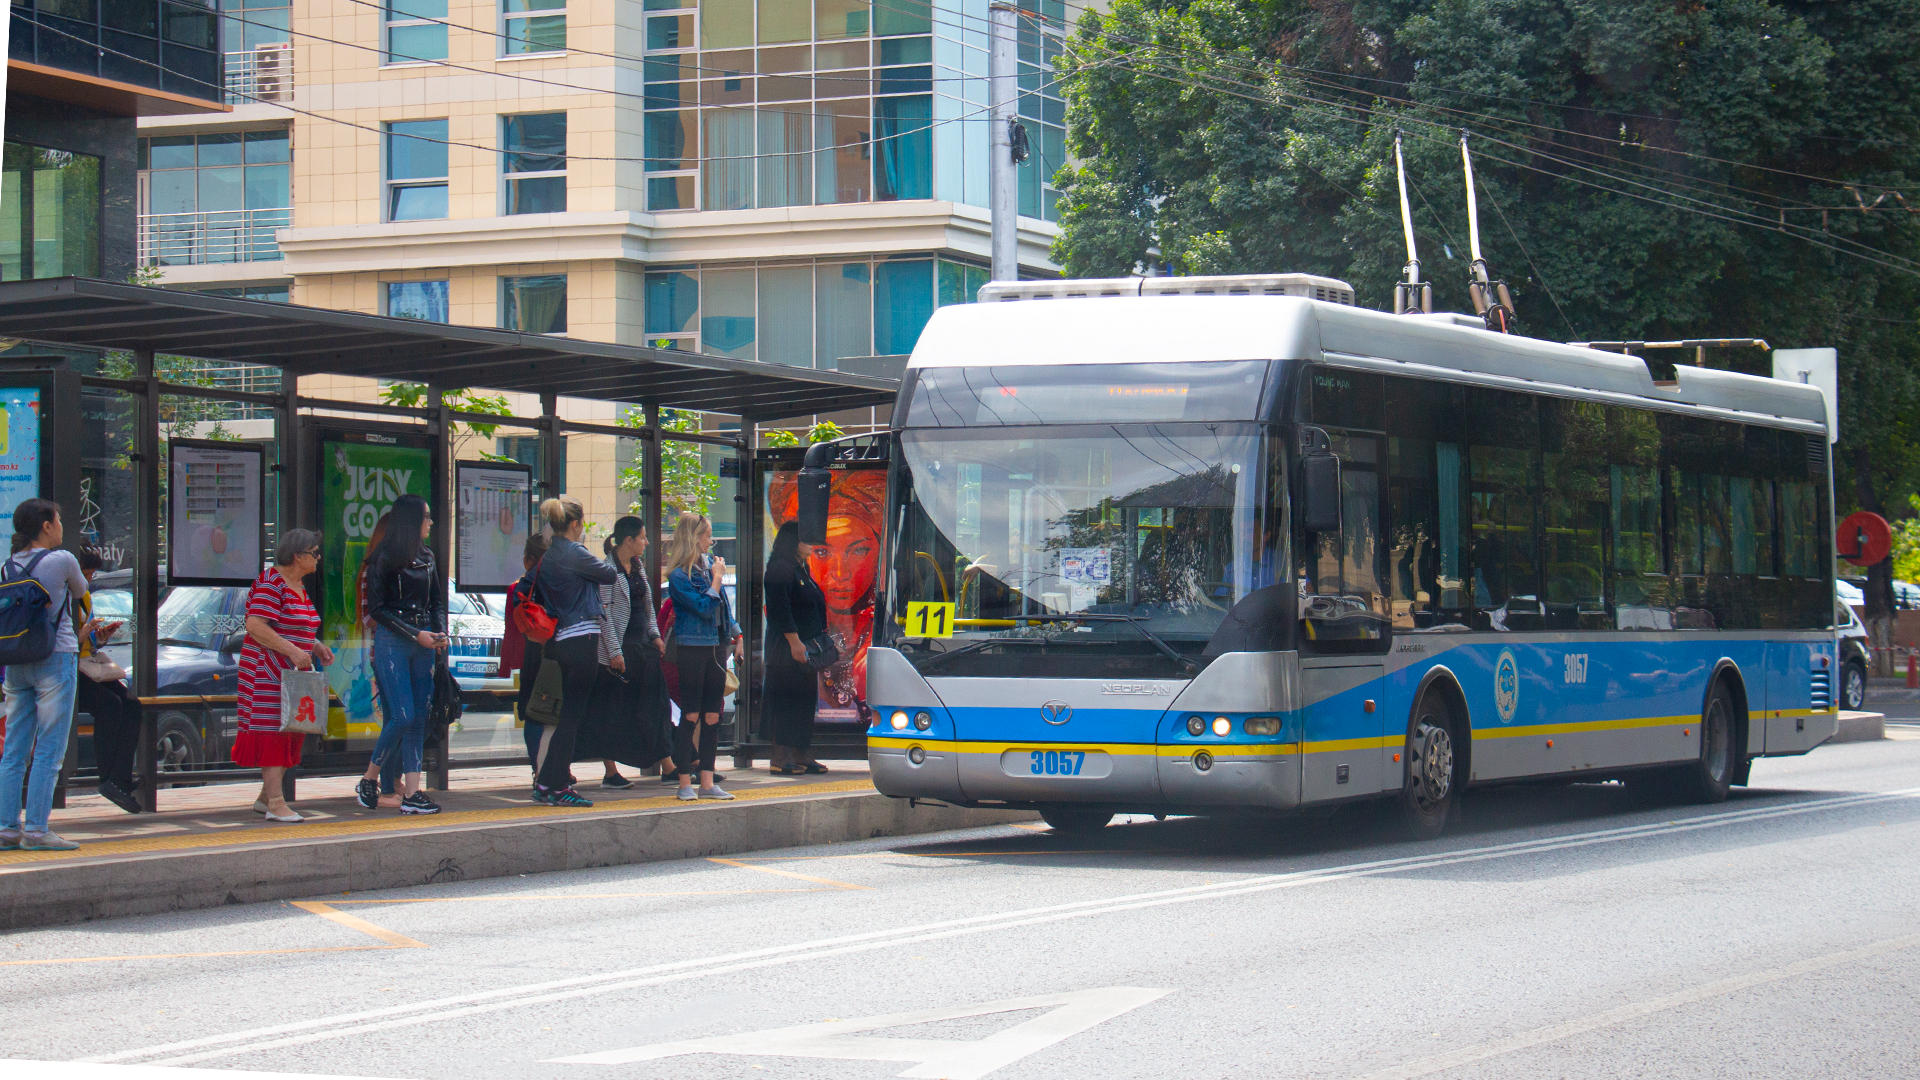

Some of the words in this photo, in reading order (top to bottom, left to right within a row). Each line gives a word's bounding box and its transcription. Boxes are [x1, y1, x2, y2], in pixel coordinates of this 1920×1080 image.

[343, 465, 413, 502] JUICY
[343, 502, 395, 538] CO
[916, 605, 946, 635] 11
[1564, 653, 1588, 684] 3057
[1101, 684, 1171, 696] NEOPLAN
[1031, 750, 1086, 776] 3057
